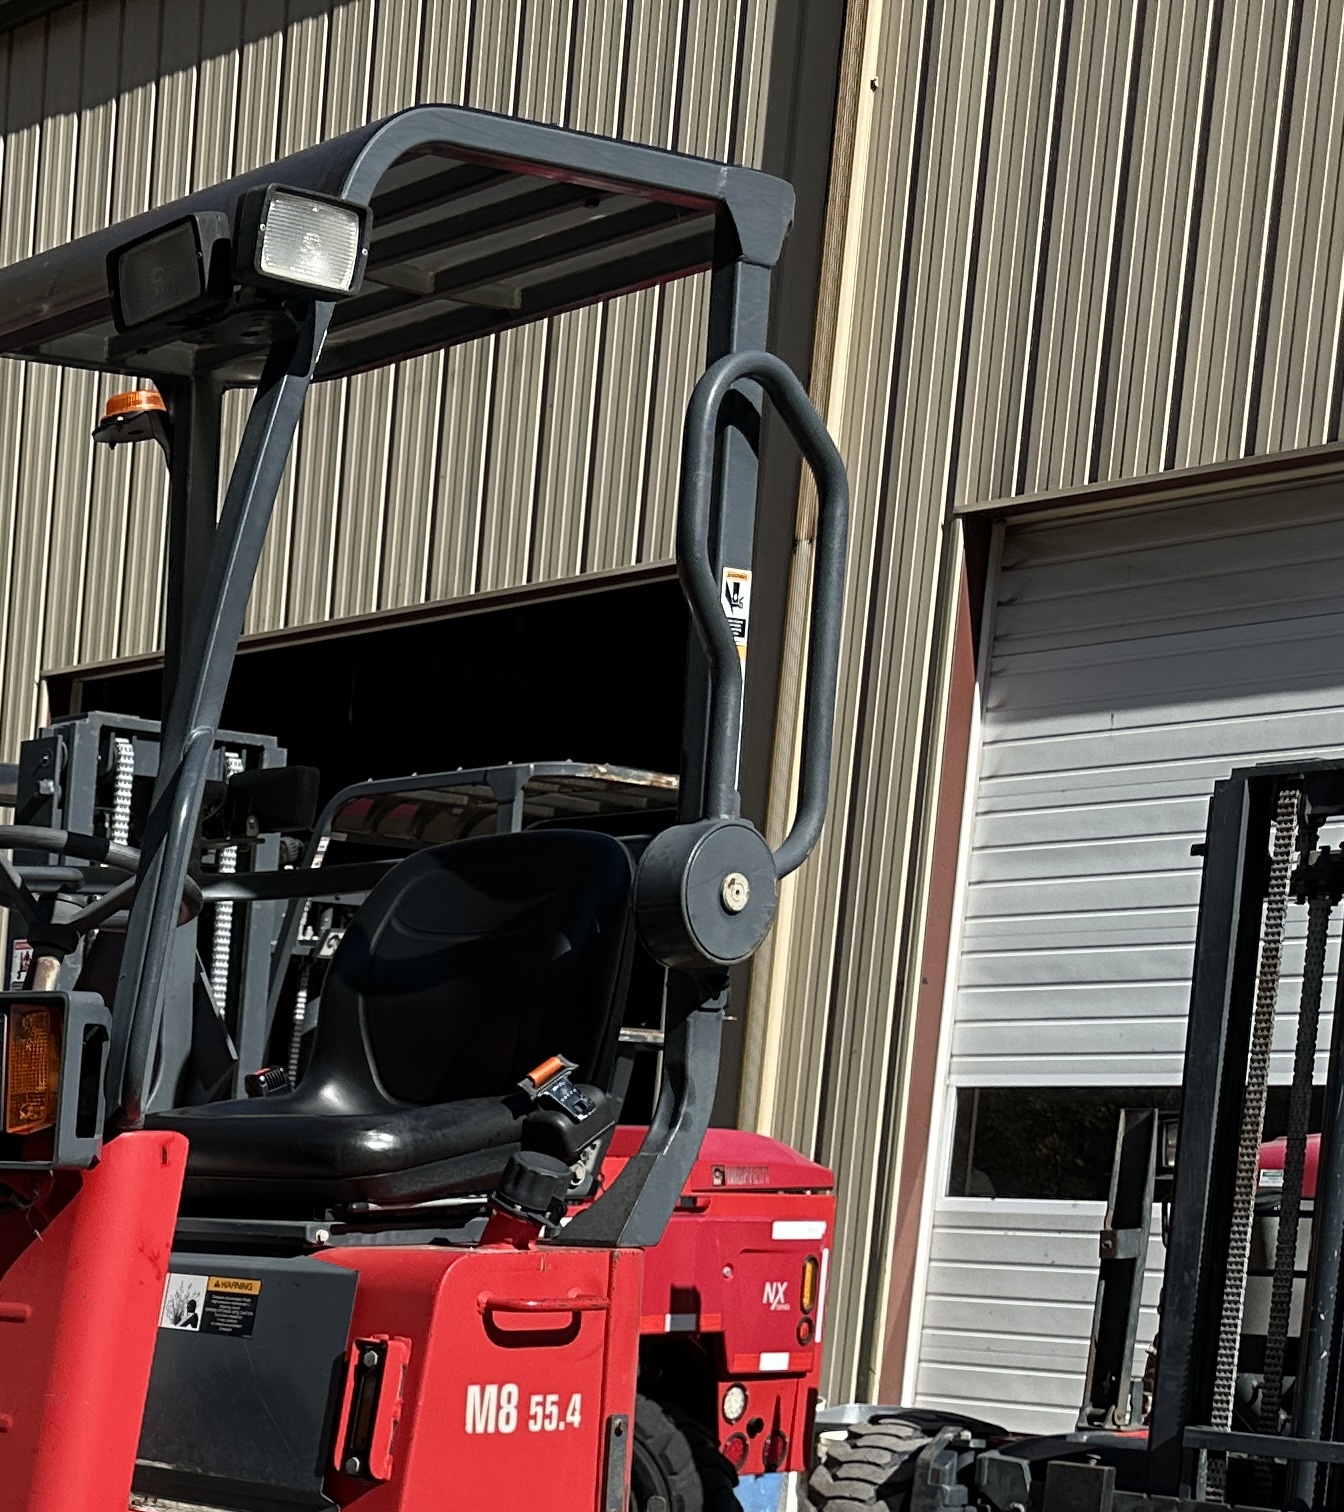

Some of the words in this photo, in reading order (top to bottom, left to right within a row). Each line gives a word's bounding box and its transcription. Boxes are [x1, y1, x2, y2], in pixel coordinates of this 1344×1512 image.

[762, 1281, 788, 1310] NX
[465, 1383, 519, 1434] M8
[528, 1393, 582, 1432] 55.4
